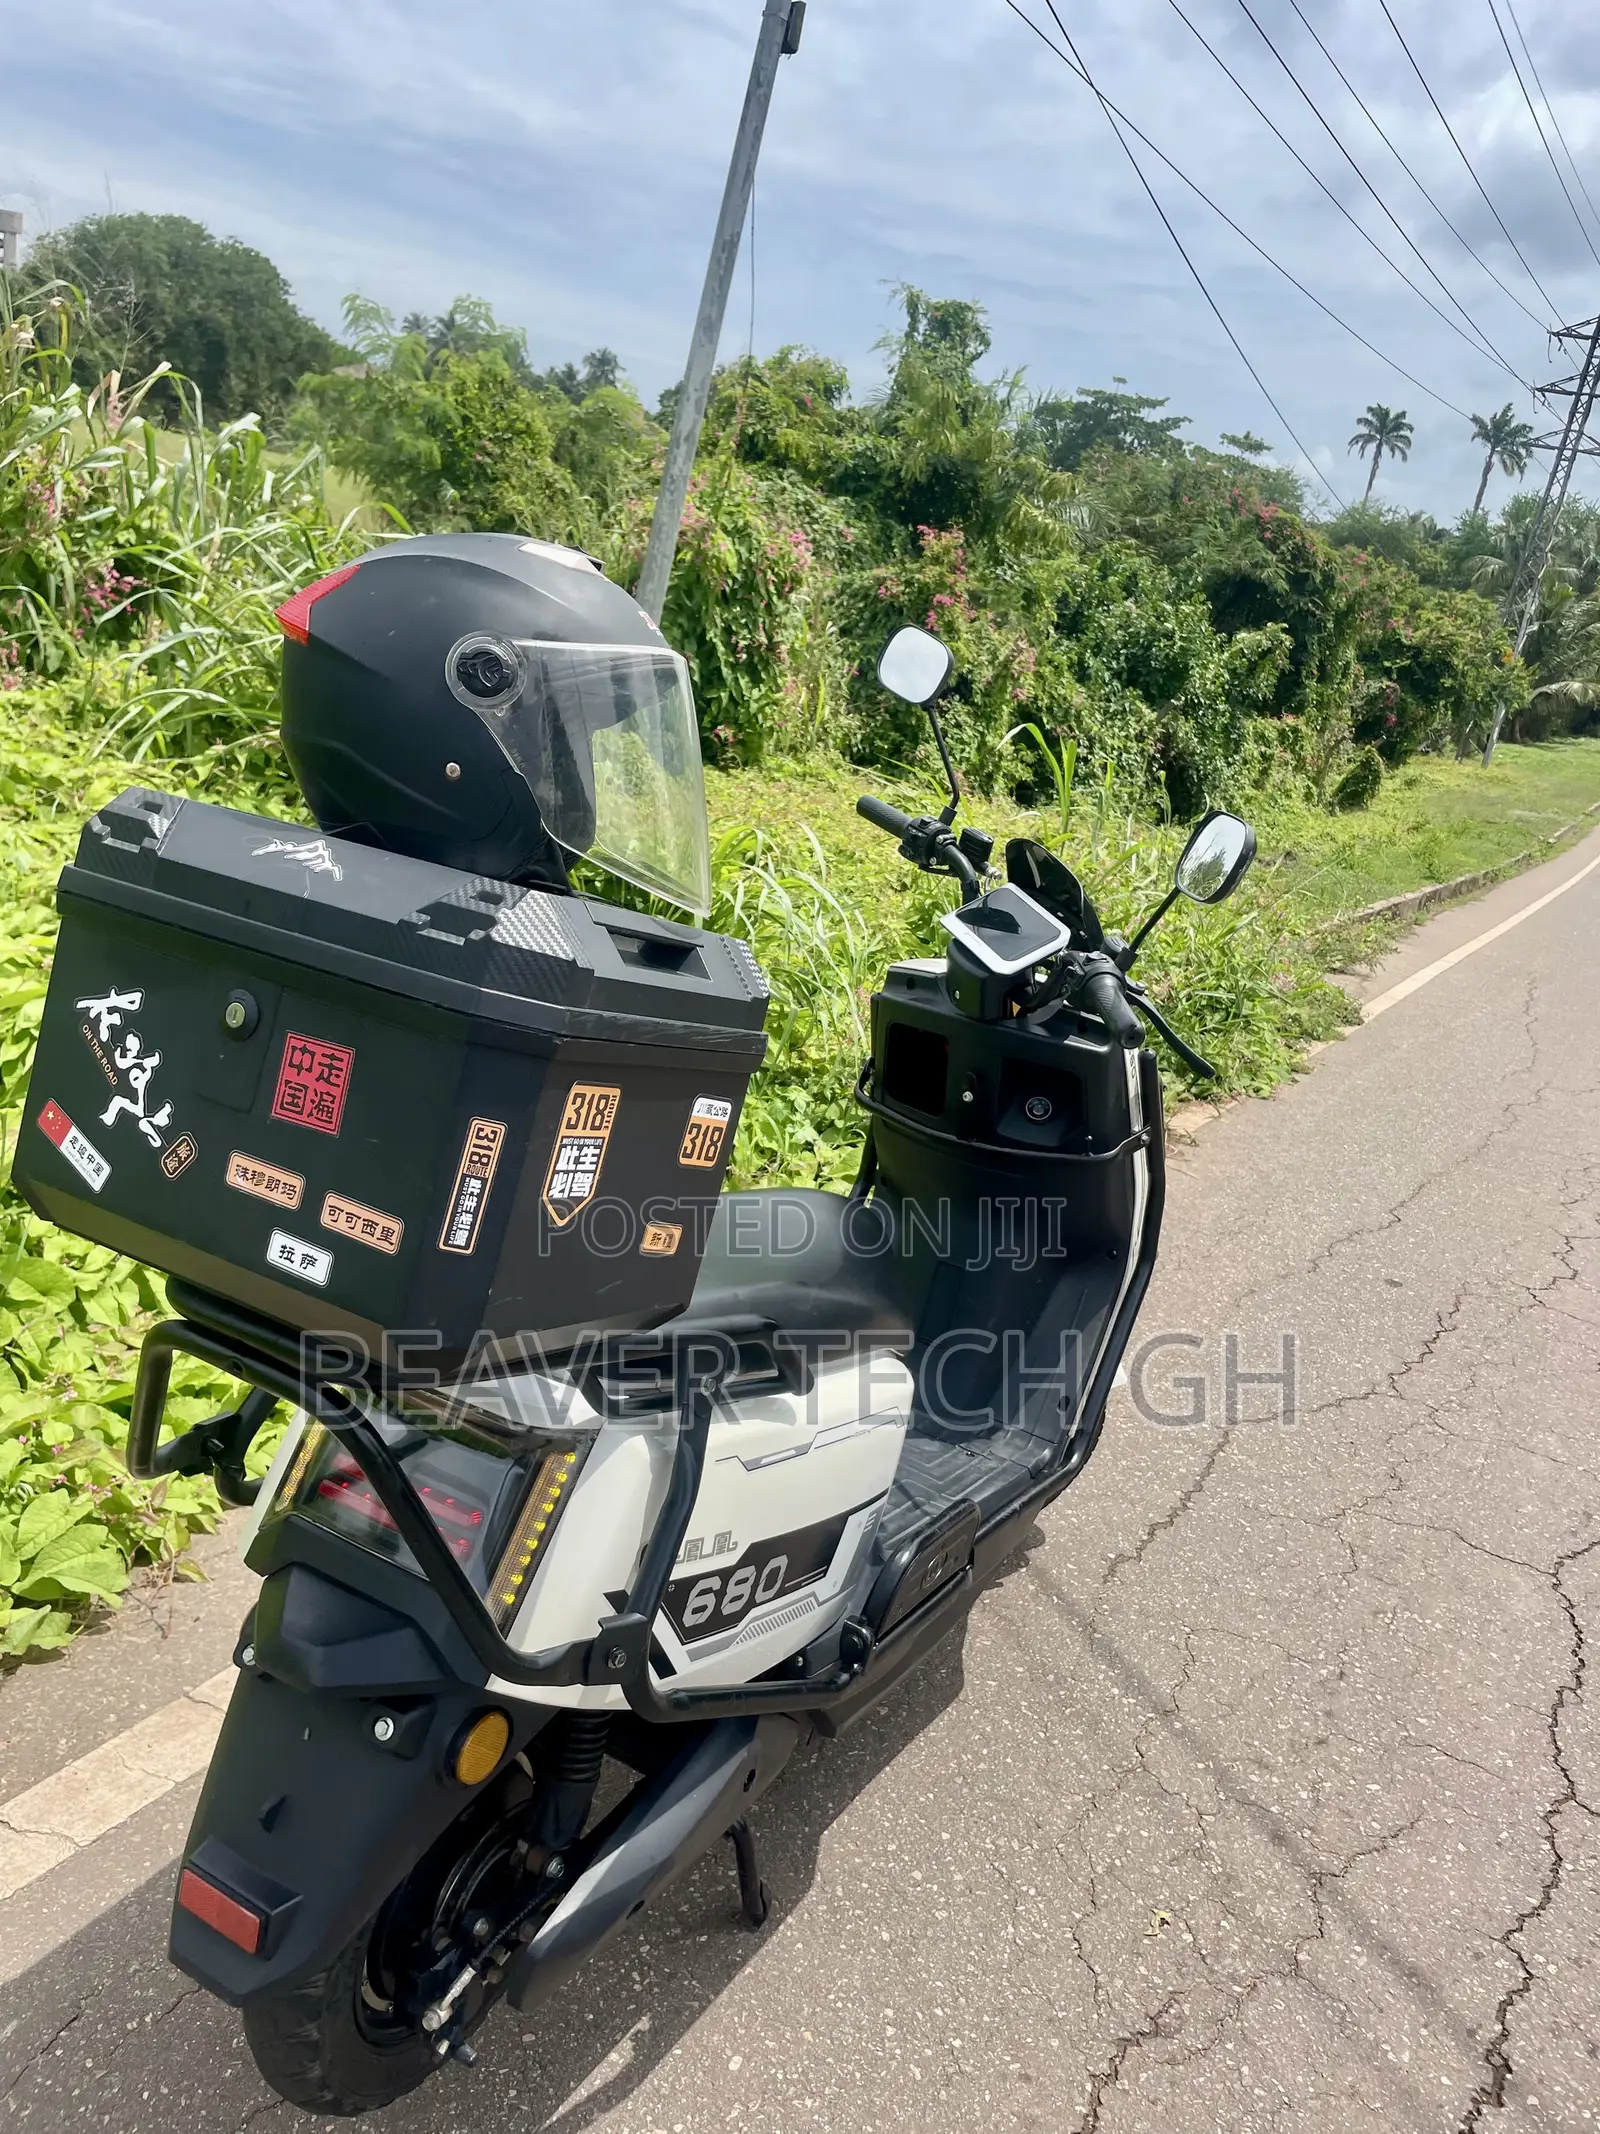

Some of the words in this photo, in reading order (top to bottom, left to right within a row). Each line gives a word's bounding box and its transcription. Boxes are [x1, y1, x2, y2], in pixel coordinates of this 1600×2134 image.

[82, 1024, 94, 1041] ON
[90, 1038, 103, 1059] THE
[100, 1058, 119, 1086] ROAD
[565, 1092, 610, 1131] 318
[603, 1095, 618, 1131] ROUTE
[468, 1127, 498, 1167] 318
[555, 1145, 601, 1171] 此生
[681, 1123, 724, 1162] 318
[233, 1163, 297, 1201] 珠穆朗玛
[461, 1177, 471, 1195] MUST
[465, 1164, 489, 1177] ROUTE
[548, 1171, 594, 1199] 必驾
[327, 1204, 395, 1246] 可可西里
[452, 1212, 461, 1231] YOUR
[279, 1243, 319, 1270] 拉萨
[681, 1554, 789, 1628] 680
